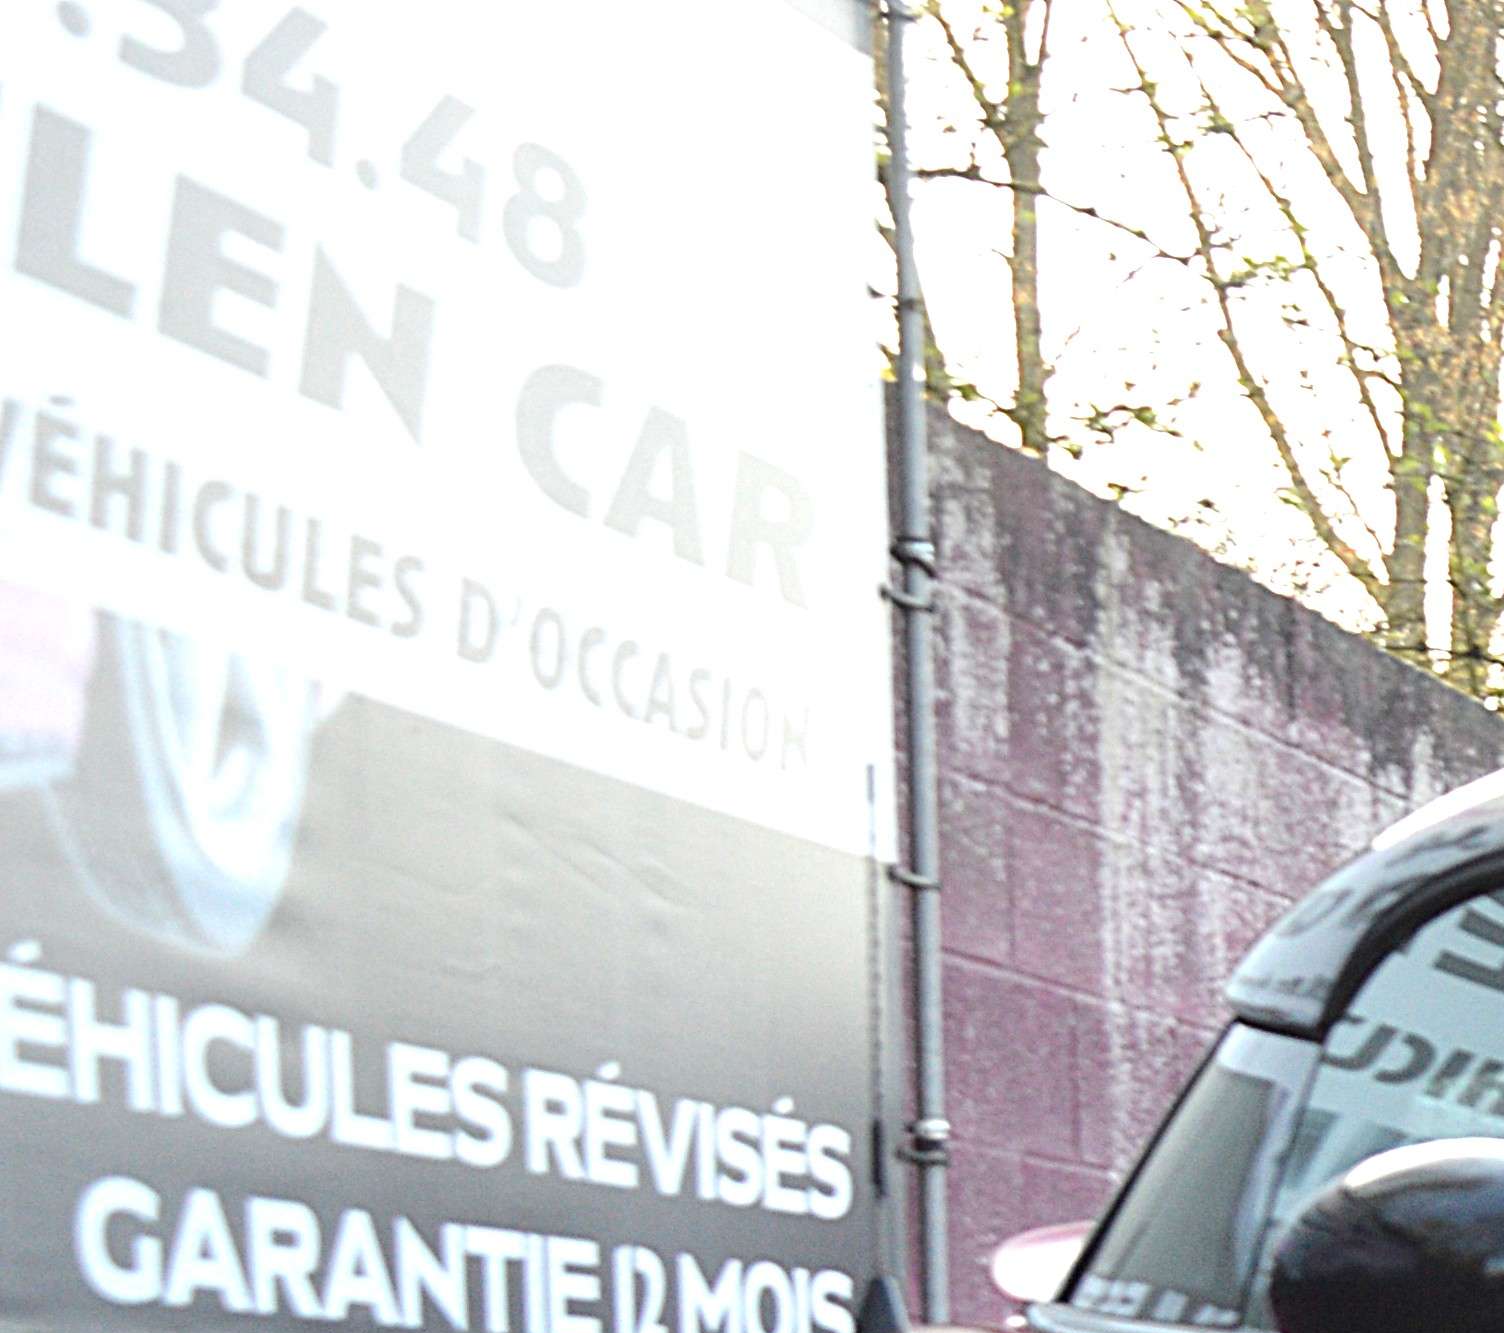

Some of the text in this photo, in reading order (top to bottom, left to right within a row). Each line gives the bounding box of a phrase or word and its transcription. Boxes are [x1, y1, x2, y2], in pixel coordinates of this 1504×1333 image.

[514, 363, 815, 610] CAR
[457, 576, 811, 771] D'OCCASION
[523, 1062, 852, 1220] RÉVISÉS
